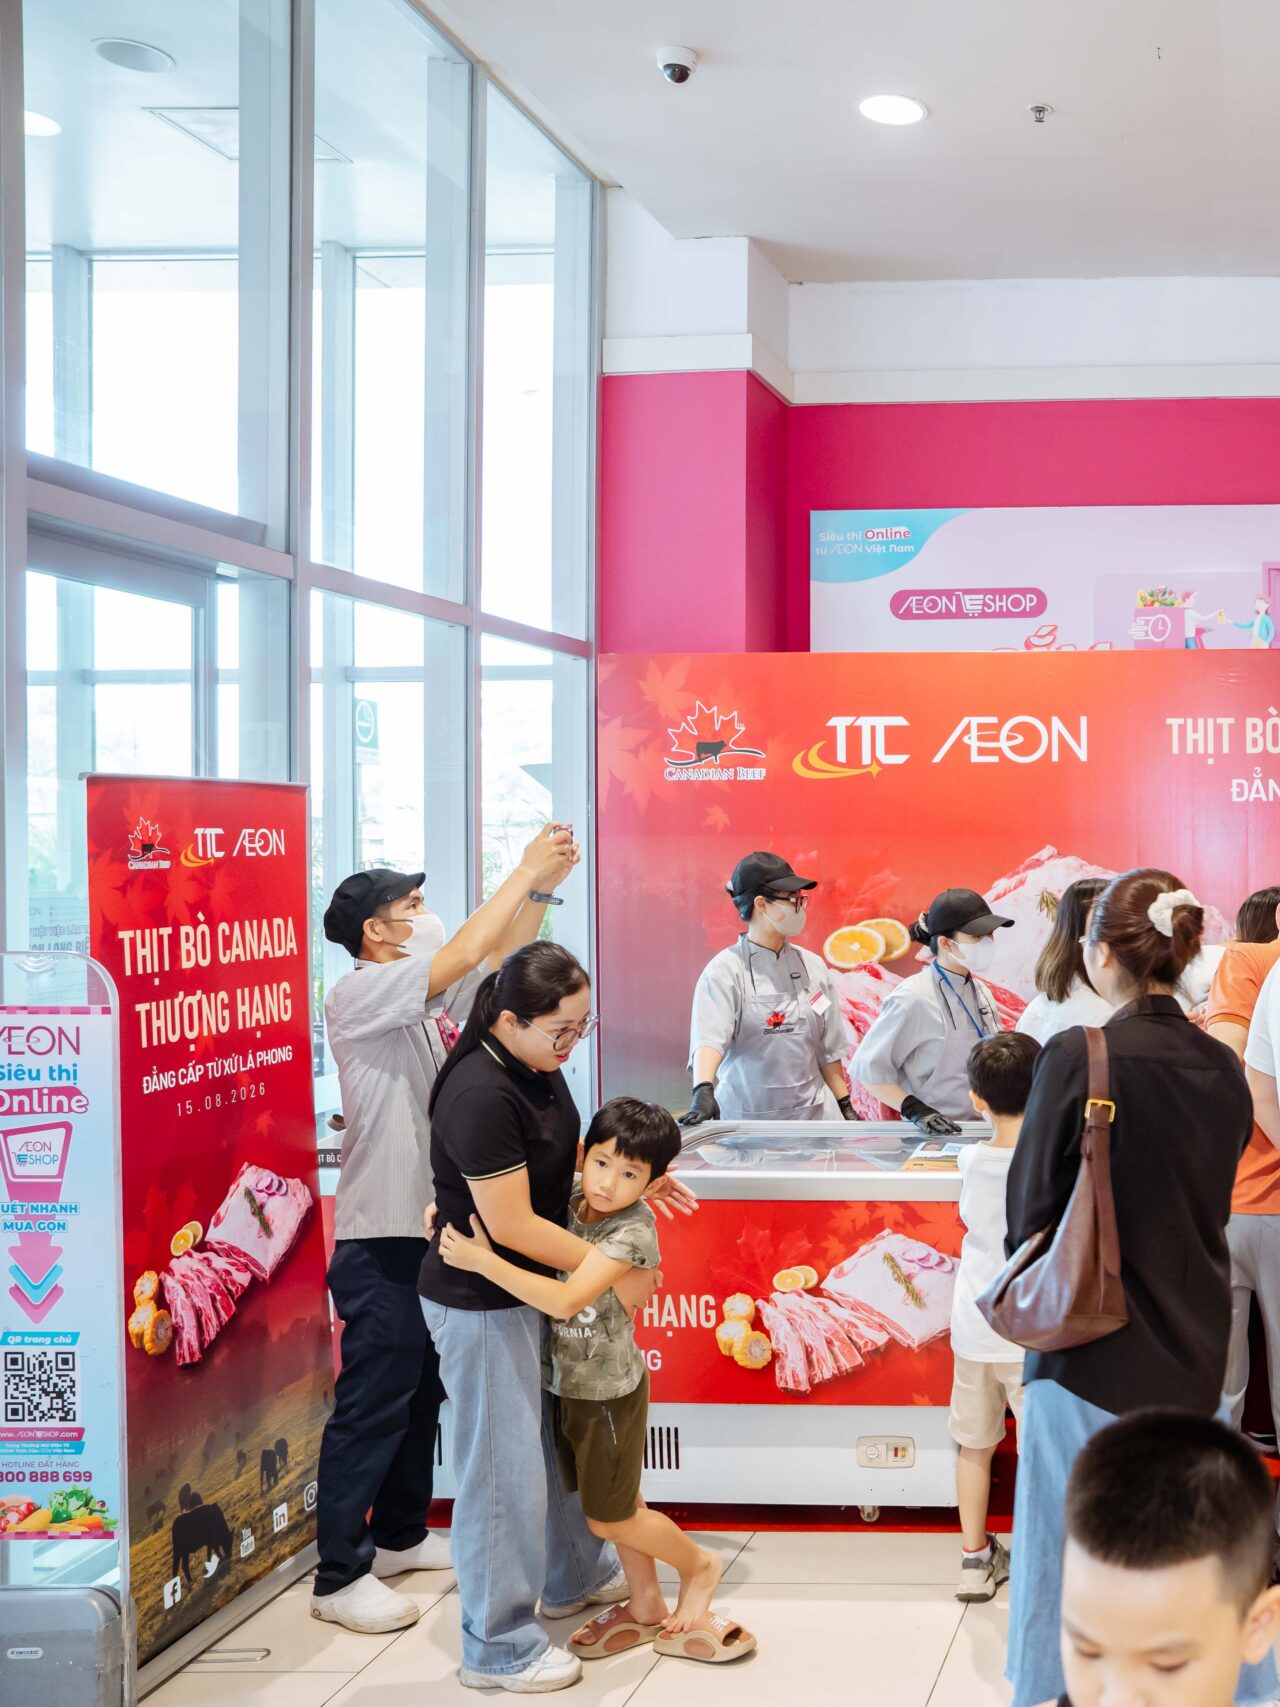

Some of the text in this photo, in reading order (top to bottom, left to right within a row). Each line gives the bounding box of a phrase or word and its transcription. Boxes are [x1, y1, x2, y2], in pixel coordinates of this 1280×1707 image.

[865, 528, 911, 540] Online
[825, 716, 911, 765] TTC
[1166, 716, 1235, 765] THỊT
[664, 767, 766, 781] CANADIAN BEEF
[193, 827, 225, 858] TTC
[118, 911, 298, 986] THỊT BÒ CANADA
[135, 981, 292, 1052] THƯỢNG HẠNG
[0, 1062, 78, 1086] Siêu thị
[143, 1045, 293, 1094] ĐẲNG CẤP TỪ XỨ LÁ PHONG
[0, 1089, 88, 1114] Online
[177, 1082, 266, 1117] 15.08.2026
[0, 1201, 79, 1214] UÉT NHANH
[3, 1220, 67, 1234] MUA GỌN
[642, 1293, 717, 1338] HẠNG
[7, 1333, 73, 1346] QR trang chủ
[0, 1471, 93, 1483] 00 888 699
